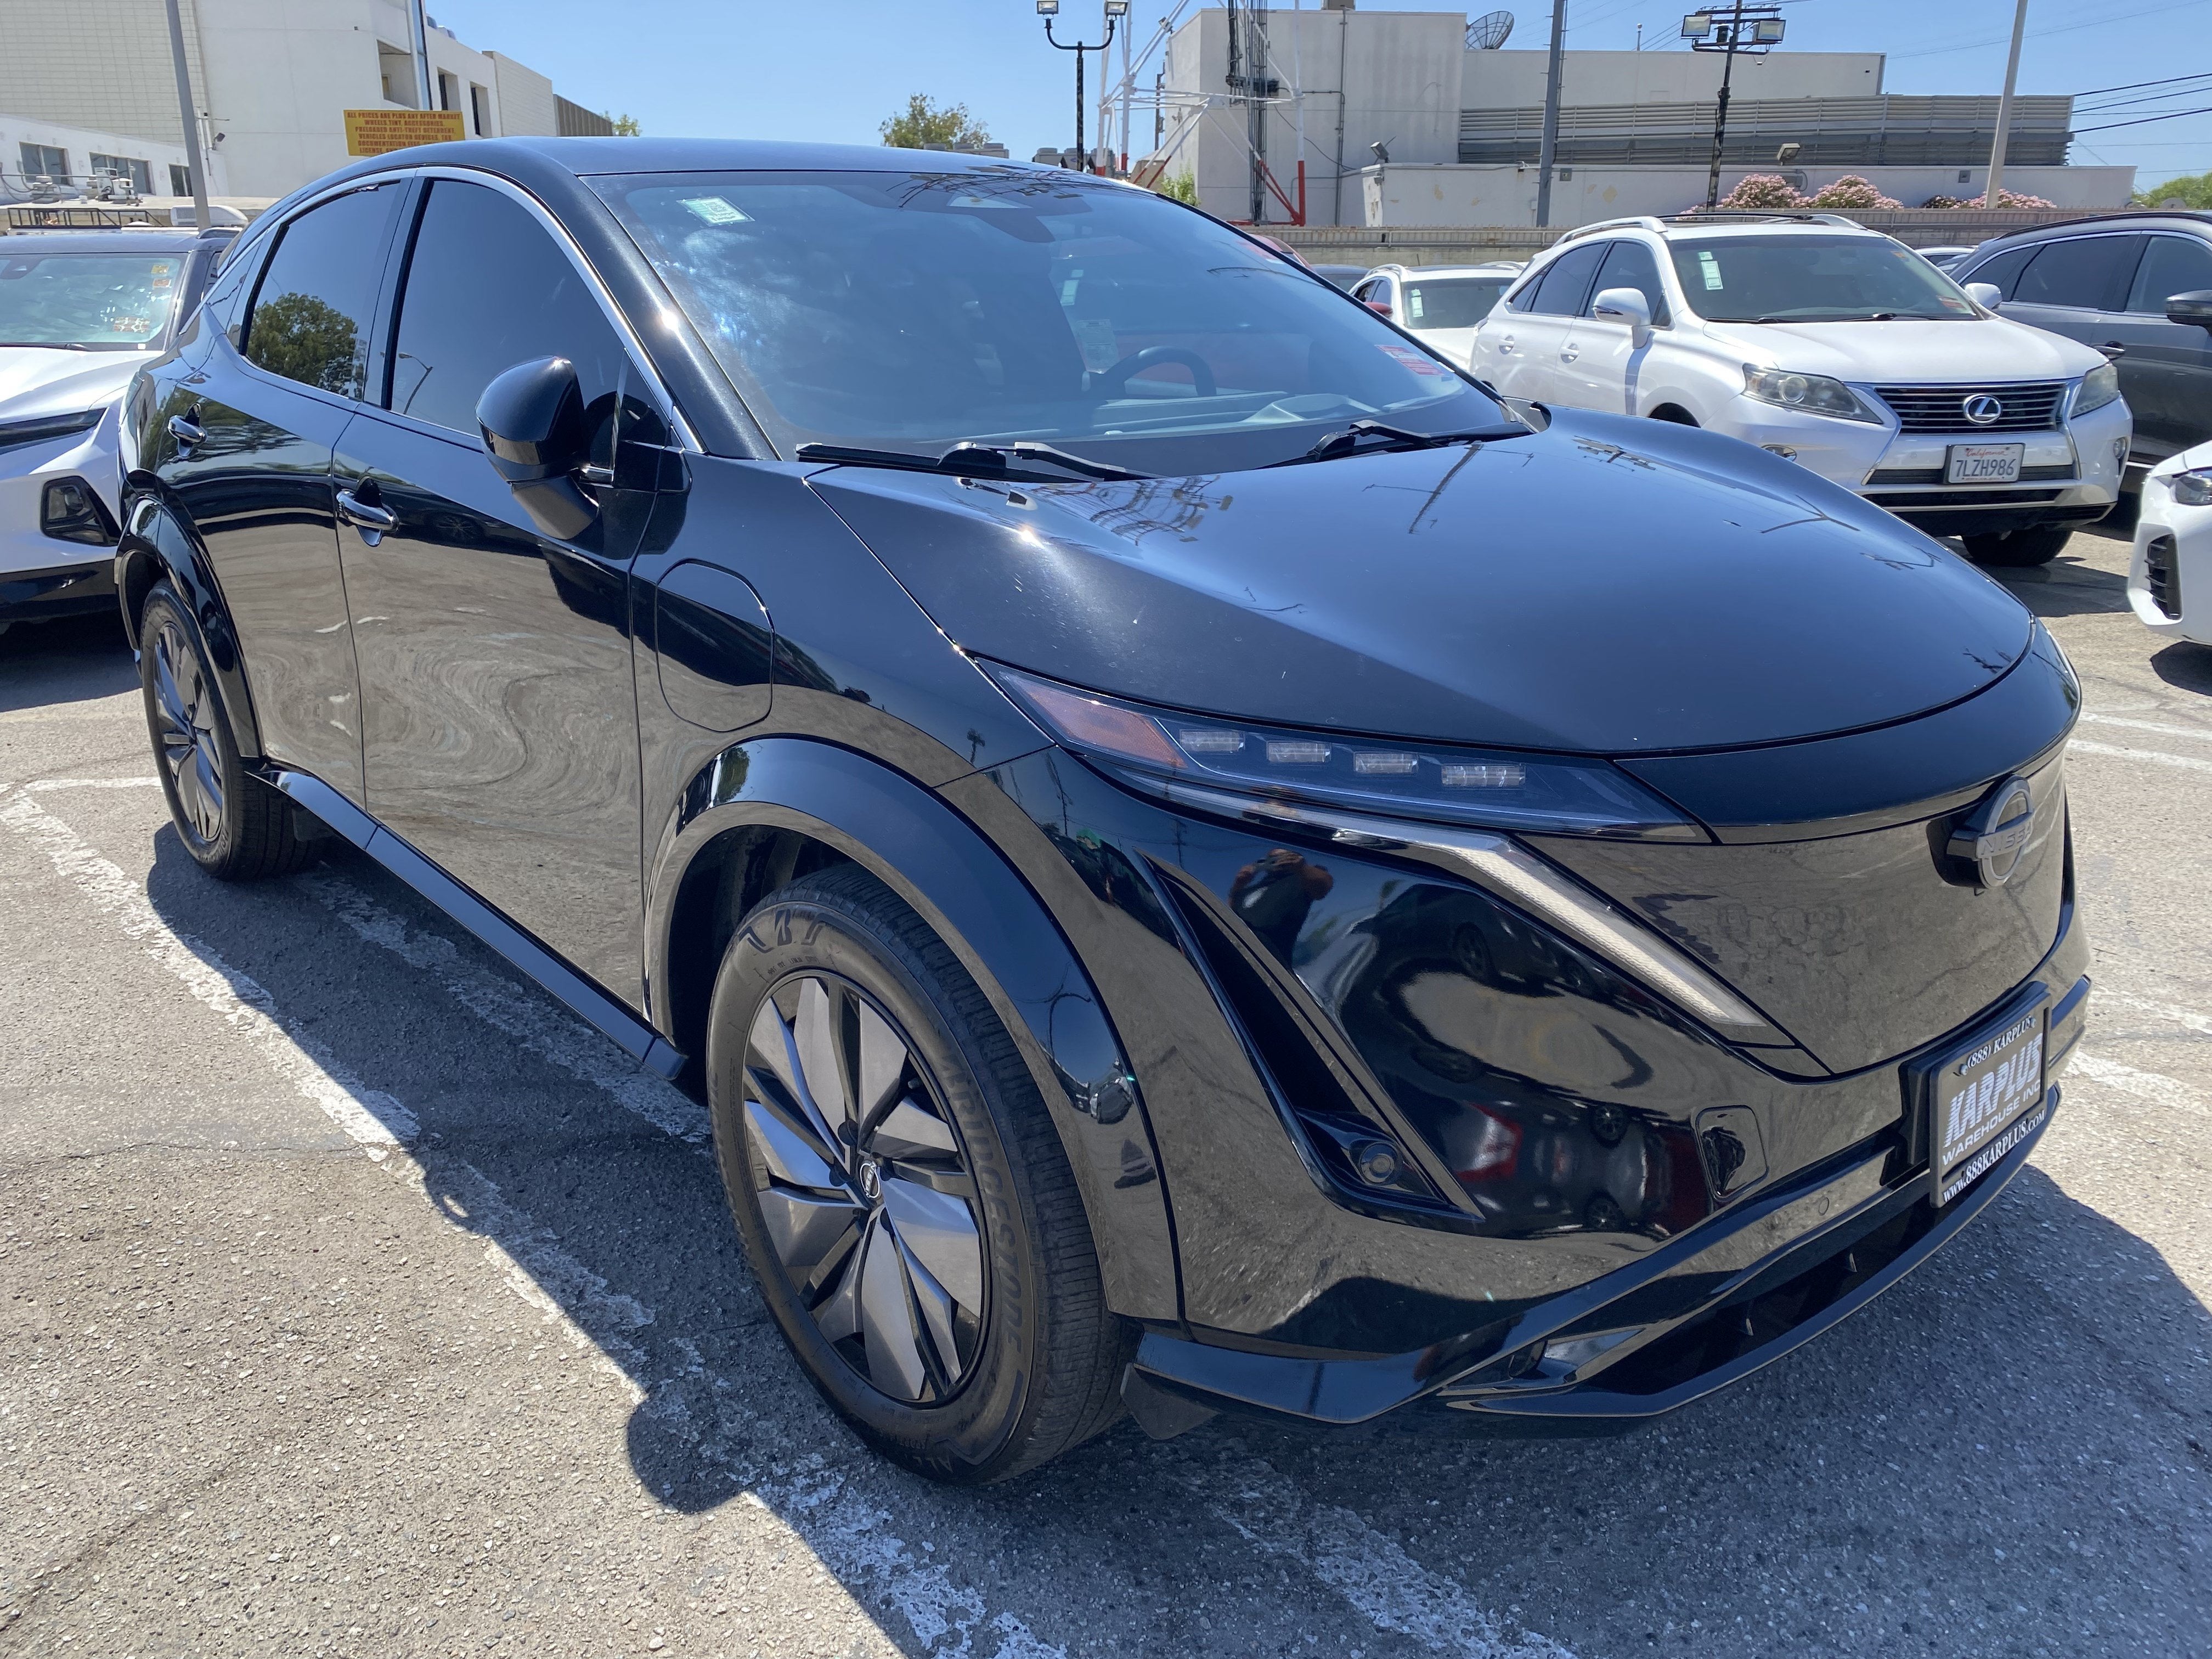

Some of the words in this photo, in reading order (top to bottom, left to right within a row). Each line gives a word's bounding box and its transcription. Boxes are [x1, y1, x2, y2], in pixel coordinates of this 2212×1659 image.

[1956, 459, 2017, 477] 7LZH986
[1966, 448, 2008, 459] California
[1980, 822, 2032, 855] NISSA
[1967, 1044, 1992, 1068] (888)
[1993, 1015, 2032, 1055] KARPLUS
[1943, 1032, 2043, 1149] KARPLUS
[1942, 1097, 2020, 1166] WAREHOUSE
[865, 1161, 877, 1198] NISSAN
[937, 1058, 1023, 1353] BRIDGESTONE
